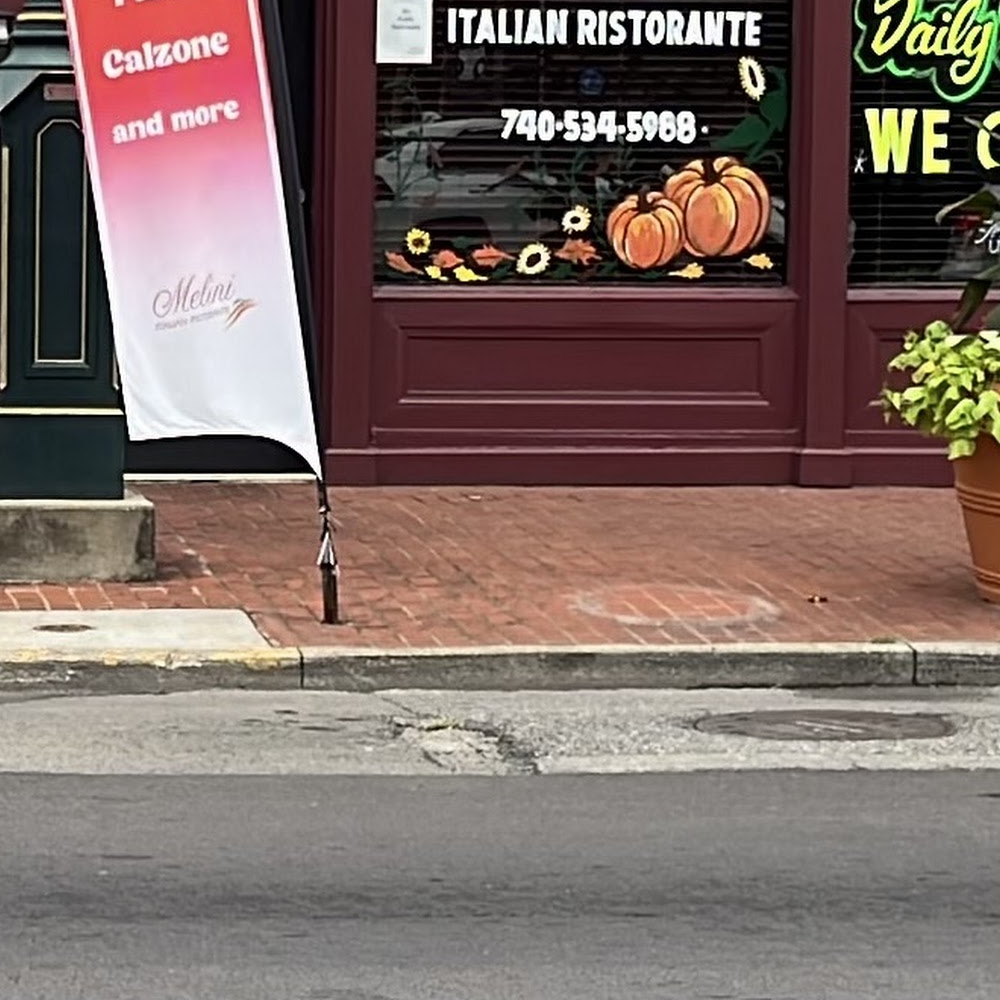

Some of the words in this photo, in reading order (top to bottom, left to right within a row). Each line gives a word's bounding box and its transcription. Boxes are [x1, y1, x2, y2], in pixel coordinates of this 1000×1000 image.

[447, 7, 569, 45] ITALIAN
[576, 10, 763, 47] RISTORANTE
[102, 31, 229, 80] Calzone
[112, 111, 164, 145] and
[170, 100, 240, 134] more
[864, 108, 950, 174] WE
[152, 273, 236, 318] Melini
